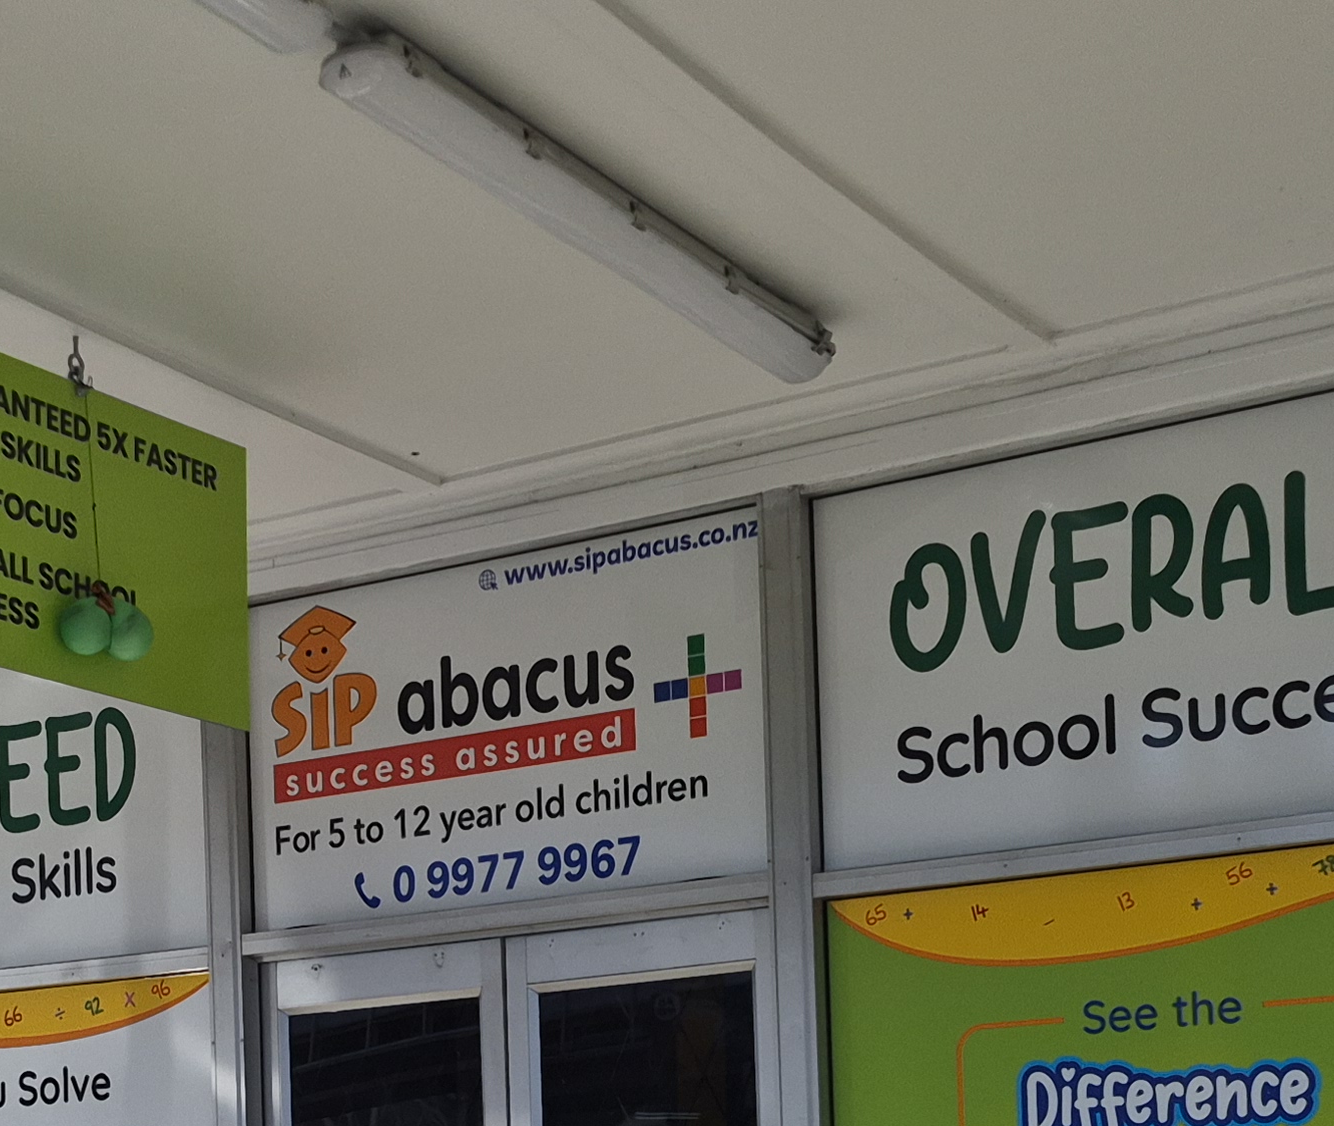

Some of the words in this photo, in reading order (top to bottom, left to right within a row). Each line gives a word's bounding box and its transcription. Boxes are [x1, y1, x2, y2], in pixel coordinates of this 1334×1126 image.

[1, 430, 82, 483] SKILLS
[96, 421, 129, 460] 5X
[134, 437, 218, 491] FASTER
[504, 518, 759, 587] www.sipabacus.co.nz
[271, 672, 377, 757] SIP
[397, 644, 635, 735] abacus
[286, 748, 436, 797] success
[456, 716, 623, 770] assured
[898, 694, 1116, 783] School
[275, 823, 321, 856] For
[328, 817, 345, 850] 5
[355, 816, 384, 844] to
[393, 805, 431, 841] 12
[440, 801, 507, 844] year
[515, 783, 565, 822] old
[575, 770, 709, 815] children
[11, 847, 117, 903] Skills
[393, 865, 415, 903] 0
[426, 851, 524, 899] 9977
[537, 835, 641, 885] 9967
[865, 904, 886, 926] 65
[970, 904, 989, 921] 14
[1117, 892, 1135, 912] 13
[1226, 862, 1253, 885] 56
[3, 1006, 23, 1027] 66
[84, 996, 105, 1016] 92
[151, 980, 171, 999] 96
[1082, 1000, 1158, 1034] See
[1173, 990, 1242, 1028] the
[18, 1066, 112, 1107] Solve
